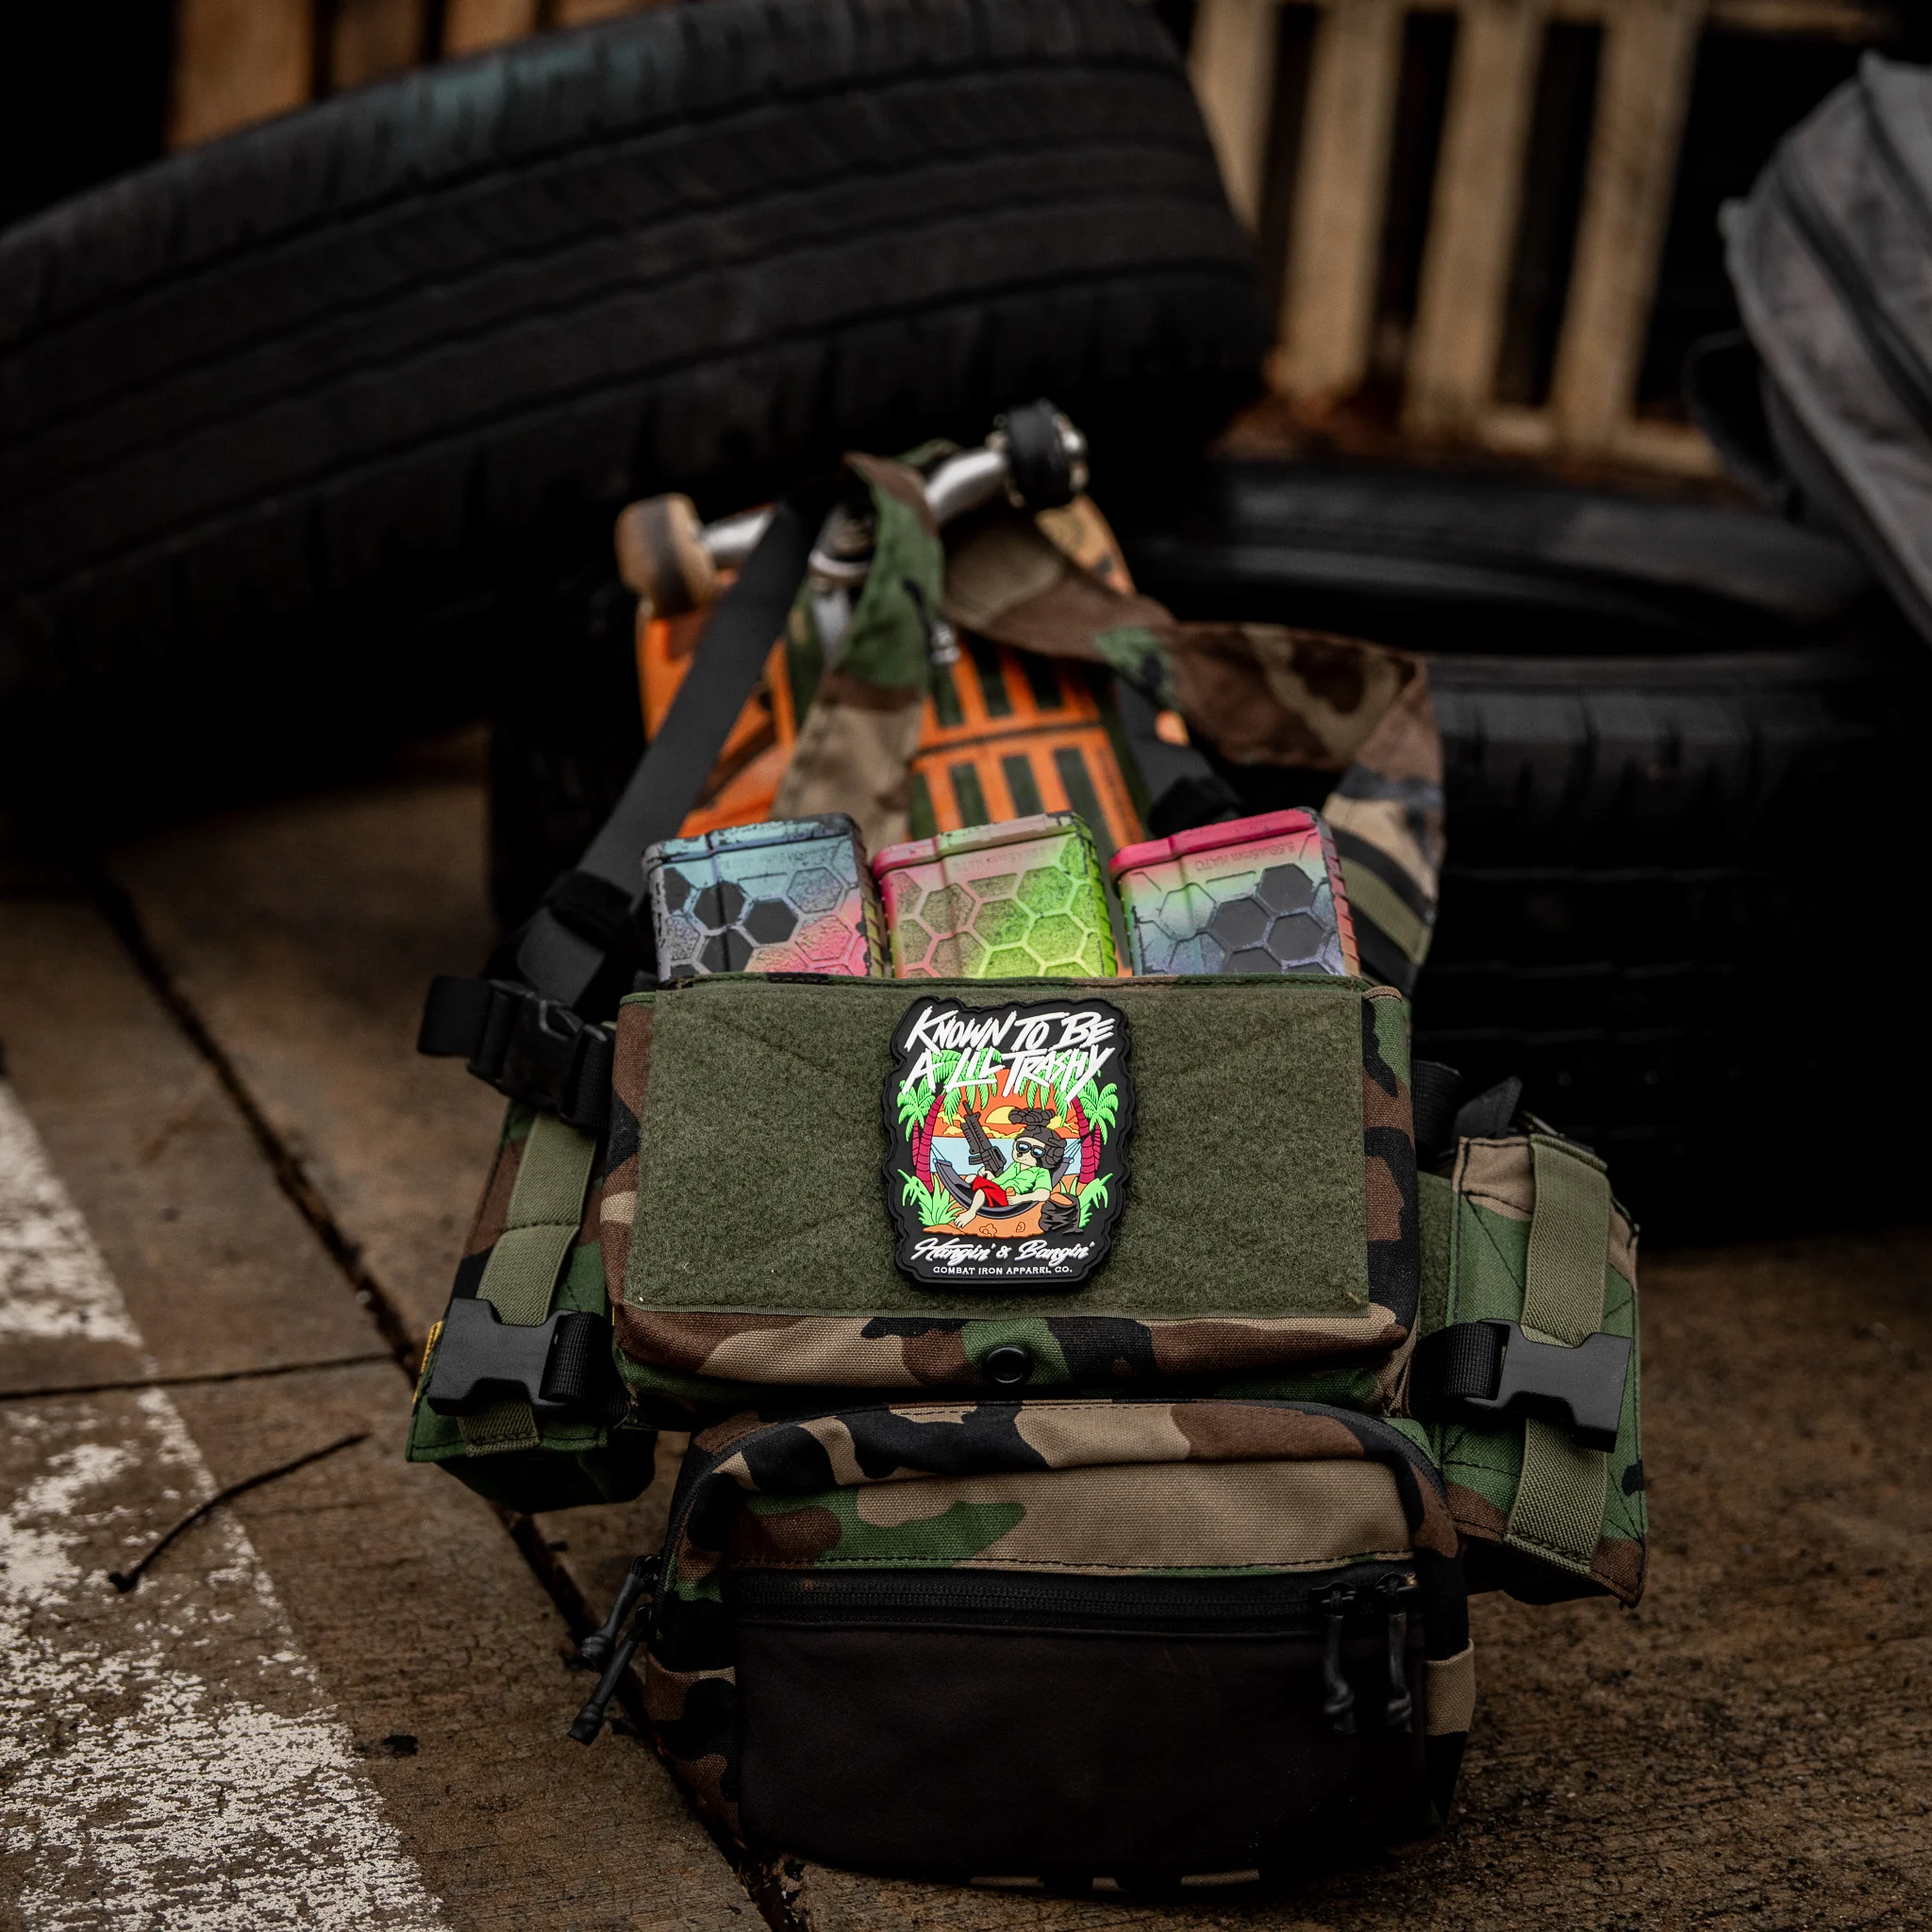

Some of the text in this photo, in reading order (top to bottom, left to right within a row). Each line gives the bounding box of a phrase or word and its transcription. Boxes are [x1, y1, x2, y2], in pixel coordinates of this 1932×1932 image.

[904, 1006, 1115, 1057] KNOWN TO BE
[901, 1044, 1115, 1109] A LIL TRASHY
[933, 1265, 1074, 1274] COMBAT IRON APPAREL CO.
[996, 1245, 1011, 1260] &
[1014, 1240, 1095, 1267] Bangin'
